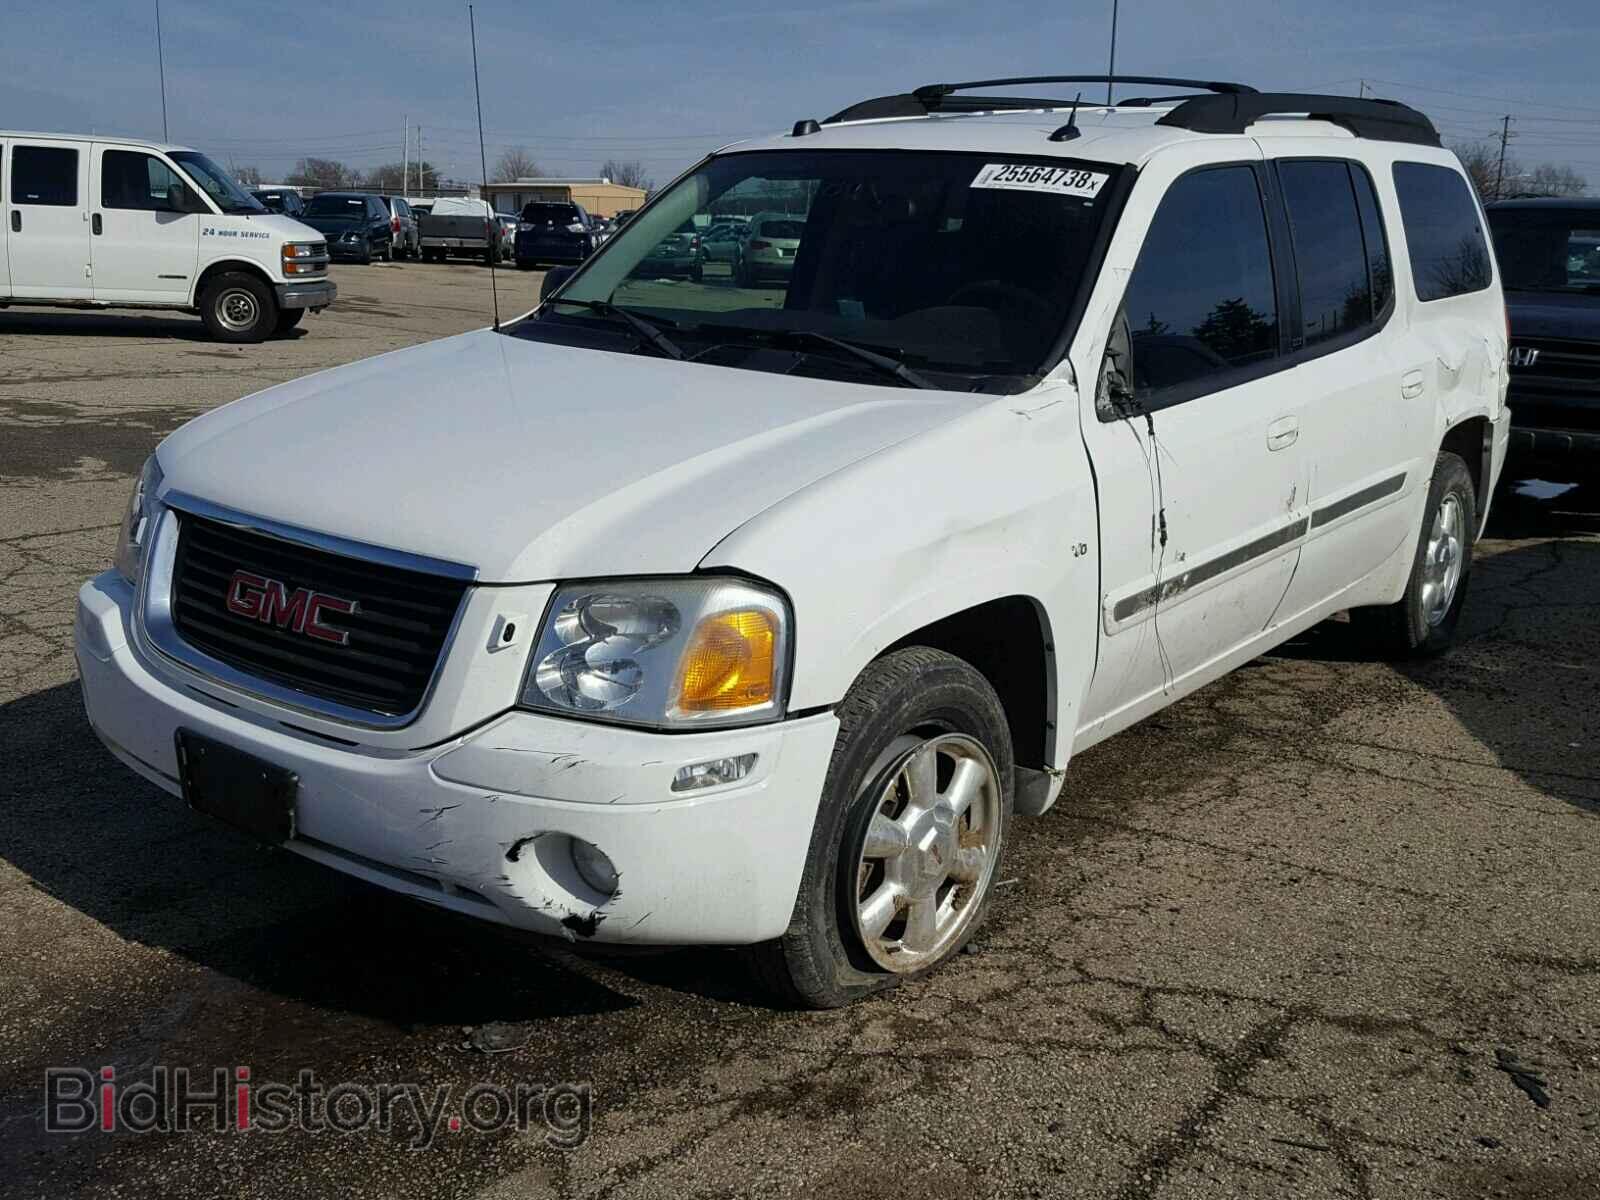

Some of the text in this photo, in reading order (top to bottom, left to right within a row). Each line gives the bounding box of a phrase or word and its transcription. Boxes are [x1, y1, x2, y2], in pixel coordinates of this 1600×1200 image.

[202, 228, 215, 236] 24
[240, 231, 270, 239] SERVICE
[227, 569, 359, 646] GMC
